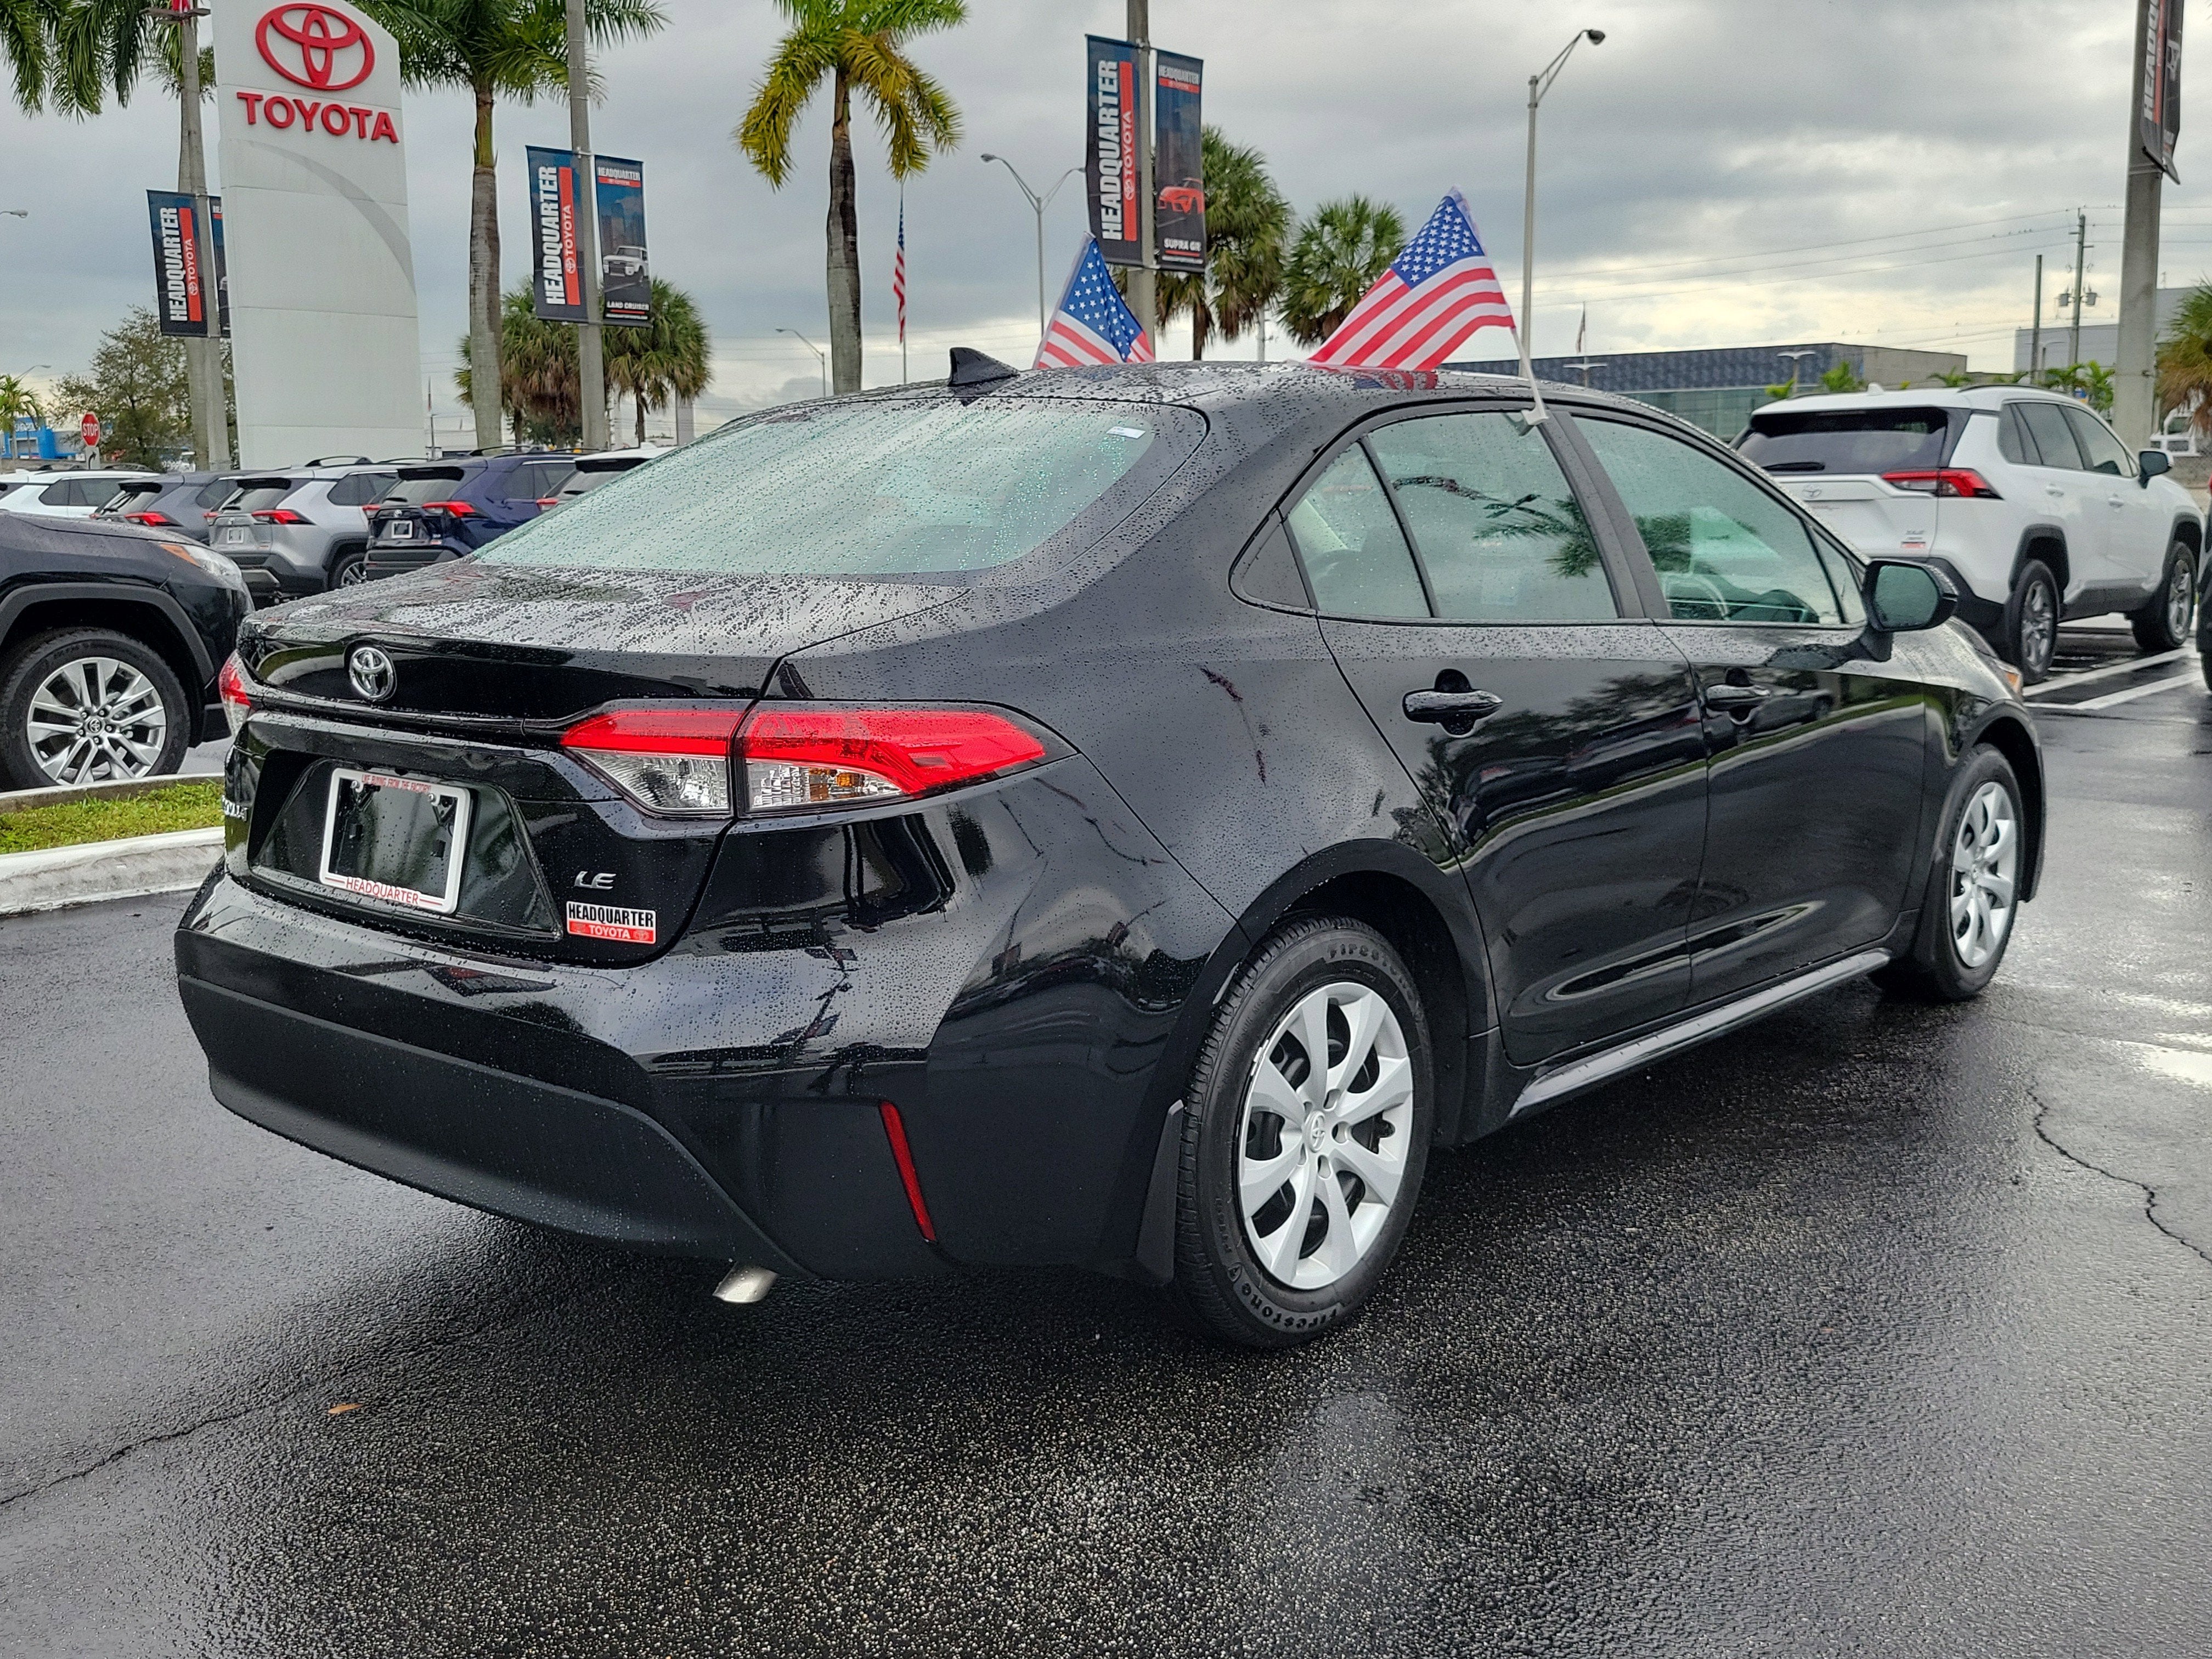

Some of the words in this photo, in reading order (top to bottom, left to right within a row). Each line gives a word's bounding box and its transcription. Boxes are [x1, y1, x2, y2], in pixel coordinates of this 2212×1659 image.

[236, 92, 399, 143] TOYOTA
[1098, 60, 1122, 240] HEADQUARTER
[1122, 111, 1134, 176] TOYOTA
[538, 166, 566, 305] HEADQUARTER
[562, 205, 573, 256] TOYOTA
[1164, 238, 1189, 250] SUPRA
[160, 207, 188, 321] HEADQUARTER
[185, 238, 196, 281] TOYOTA
[83, 423, 98, 436] STOP
[387, 778, 400, 788] FROM
[346, 877, 419, 905] HEADQUARTER
[574, 871, 617, 890] LE
[568, 903, 654, 928] HEADQUARTER
[589, 924, 631, 939] TOYOTA
[1241, 1282, 1337, 1329] Firestone
